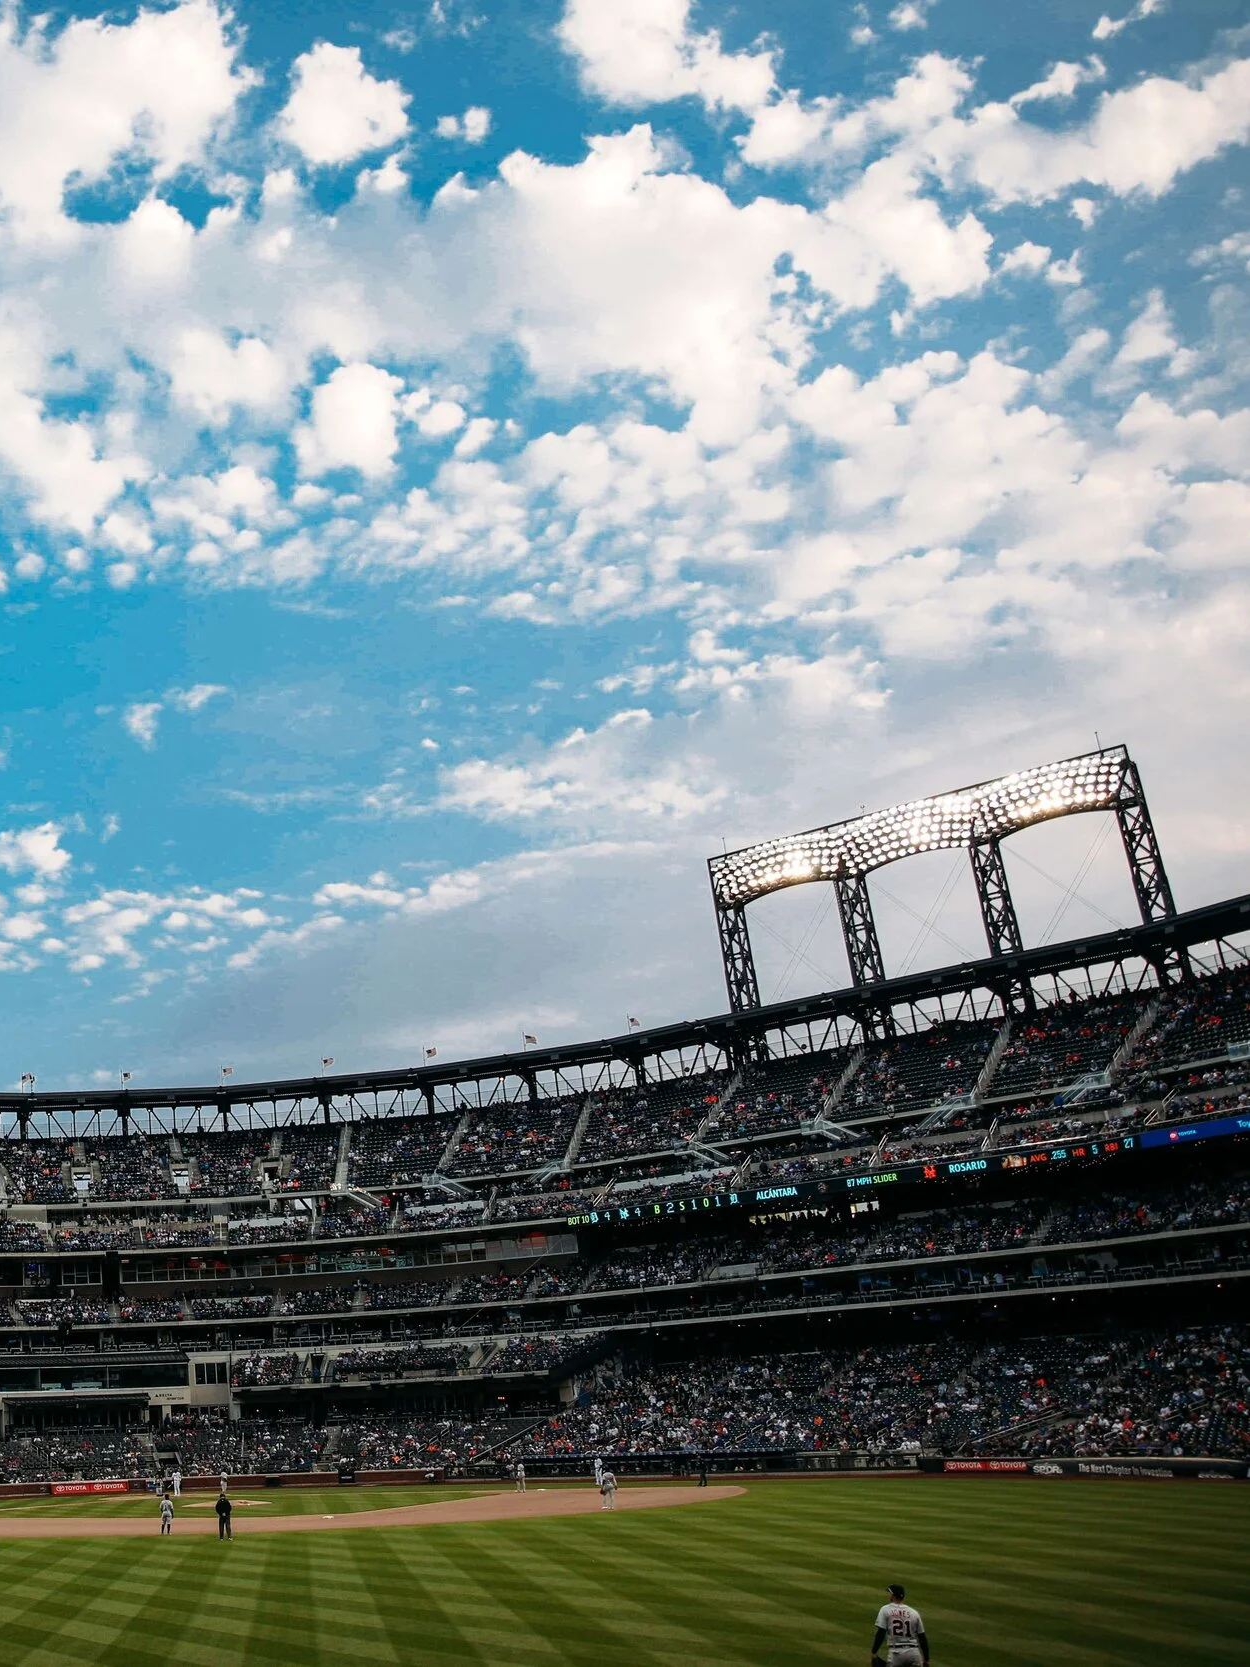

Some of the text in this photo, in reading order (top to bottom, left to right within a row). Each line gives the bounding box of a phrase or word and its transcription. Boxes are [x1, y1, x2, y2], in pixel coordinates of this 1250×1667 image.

[1178, 1129, 1197, 1137] TOYOTA
[948, 1160, 987, 1174] ROSARIO
[1030, 1153, 1047, 1162] AVG
[1050, 1149, 1067, 1160] .255
[1071, 1148, 1086, 1157] HR
[1091, 1144, 1098, 1155] 5
[1104, 1142, 1119, 1152] RBI
[1123, 1137, 1134, 1149] 27
[846, 1173, 898, 1188] 87 MPH SLIDER
[756, 1187, 798, 1200] ALCÁNTARA
[567, 1216, 580, 1226] BOT
[581, 1215, 590, 1224] 10
[604, 1211, 610, 1221] 4
[634, 1207, 641, 1217] 4
[653, 1204, 661, 1215] B
[665, 1202, 675, 1213] 2
[678, 1201, 686, 1211] S
[691, 1198, 698, 1210] 1
[714, 1195, 721, 1207] 1
[956, 1461, 983, 1469] TOYOTA
[1000, 1461, 1027, 1469] TOYOTA
[1078, 1463, 1090, 1473] The
[1091, 1464, 1106, 1474] Next
[1106, 1465, 1131, 1476] Chapter
[892, 1619, 912, 1638] 21
